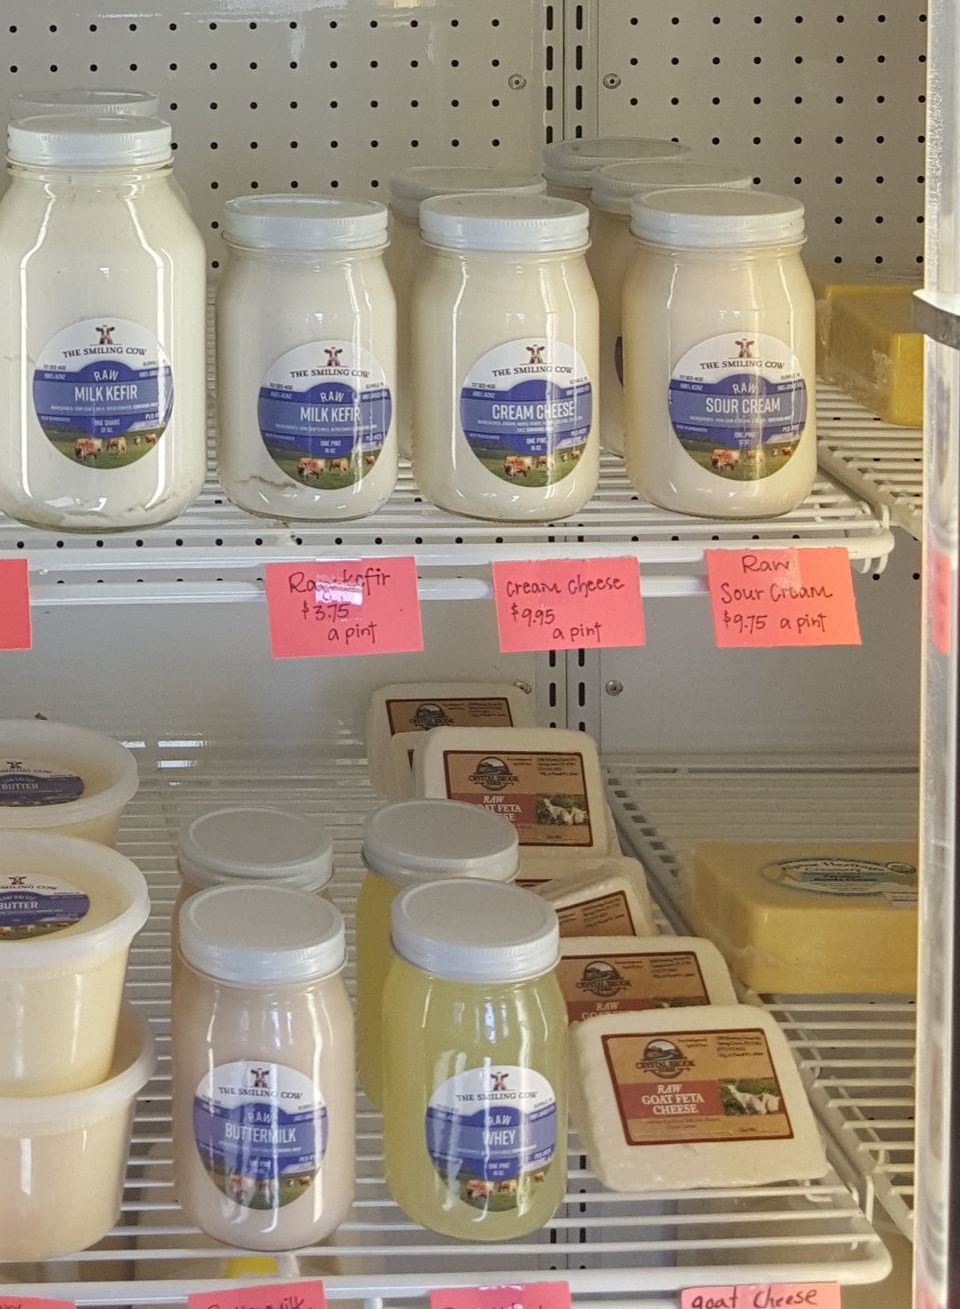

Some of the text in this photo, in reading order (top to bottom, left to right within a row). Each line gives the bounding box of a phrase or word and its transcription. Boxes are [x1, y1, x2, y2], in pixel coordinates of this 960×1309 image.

[94, 370, 119, 381] RAW
[75, 385, 138, 401] MILK KEFIR
[300, 407, 361, 422] MILK KEFIR
[492, 401, 575, 419] CREAM CHEESE
[706, 398, 781, 413] SOUR CREAM
[742, 555, 790, 573] Raw
[721, 583, 833, 604] Sour Cream
[302, 601, 349, 622] $3.75
[512, 603, 555, 626] $9.95
[723, 610, 826, 634] $9.75 a pint
[328, 622, 377, 644] a pint
[553, 622, 602, 642] a pint
[658, 1084, 682, 1093] RAW
[642, 1094, 704, 1104] GOAT FETA
[653, 1104, 698, 1114] CHEESE
[225, 1122, 296, 1142] BUTTERMILK
[482, 1130, 516, 1145] WHEY
